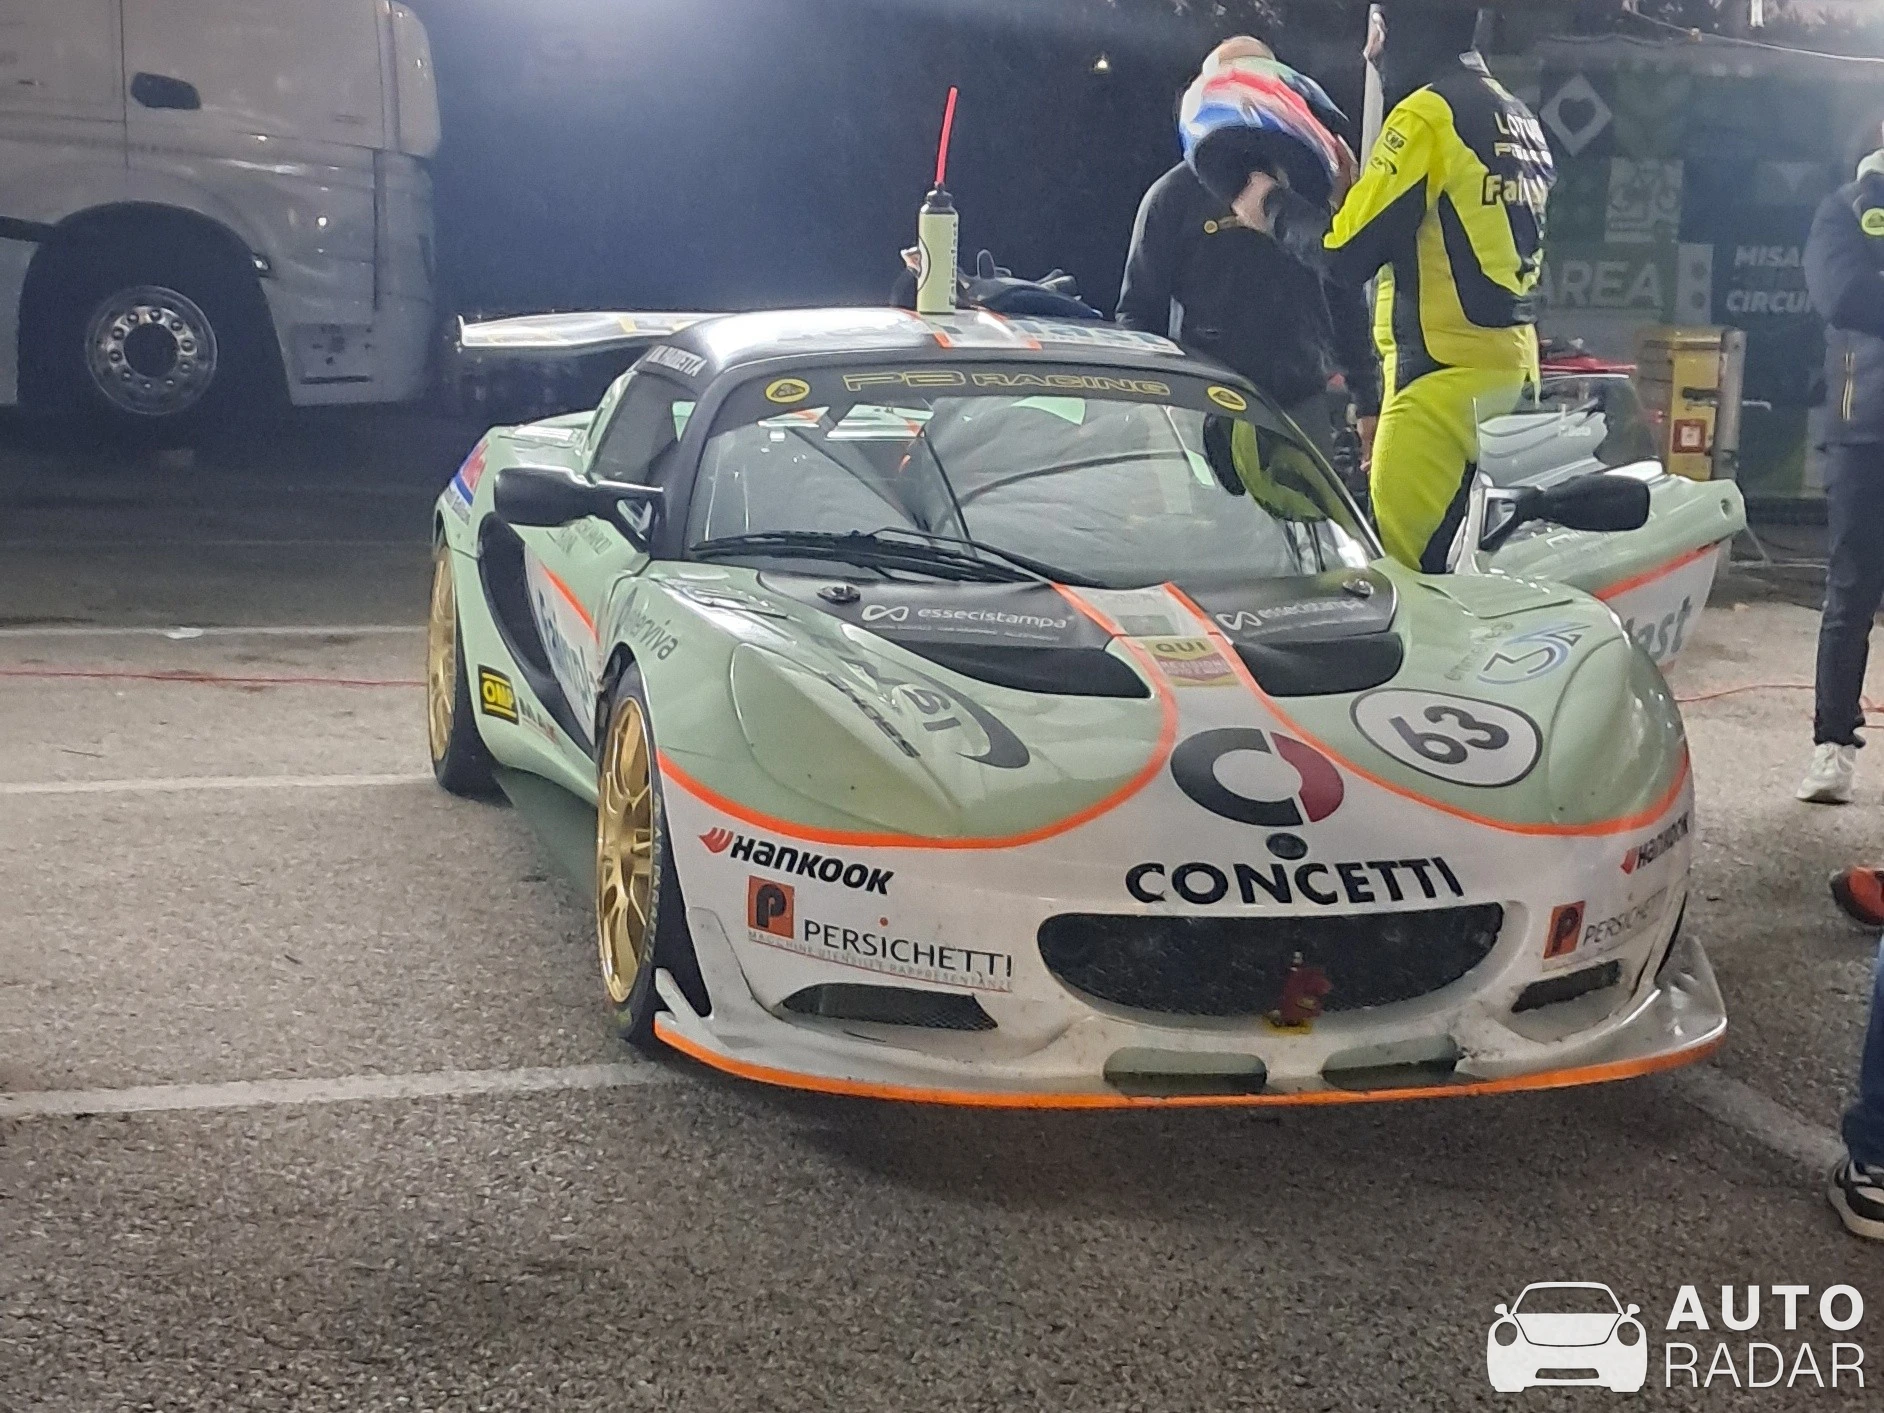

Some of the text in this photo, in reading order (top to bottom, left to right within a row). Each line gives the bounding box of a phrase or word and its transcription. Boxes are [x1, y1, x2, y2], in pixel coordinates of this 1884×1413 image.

[1734, 244, 1801, 267] MISA
[971, 374, 1171, 395] RACING
[917, 607, 1068, 629] essecistampa
[1155, 641, 1207, 653] QUI
[1388, 705, 1510, 765] 63
[1125, 857, 1465, 905] CONCETTI
[803, 919, 1013, 978] PERSICHETTI
